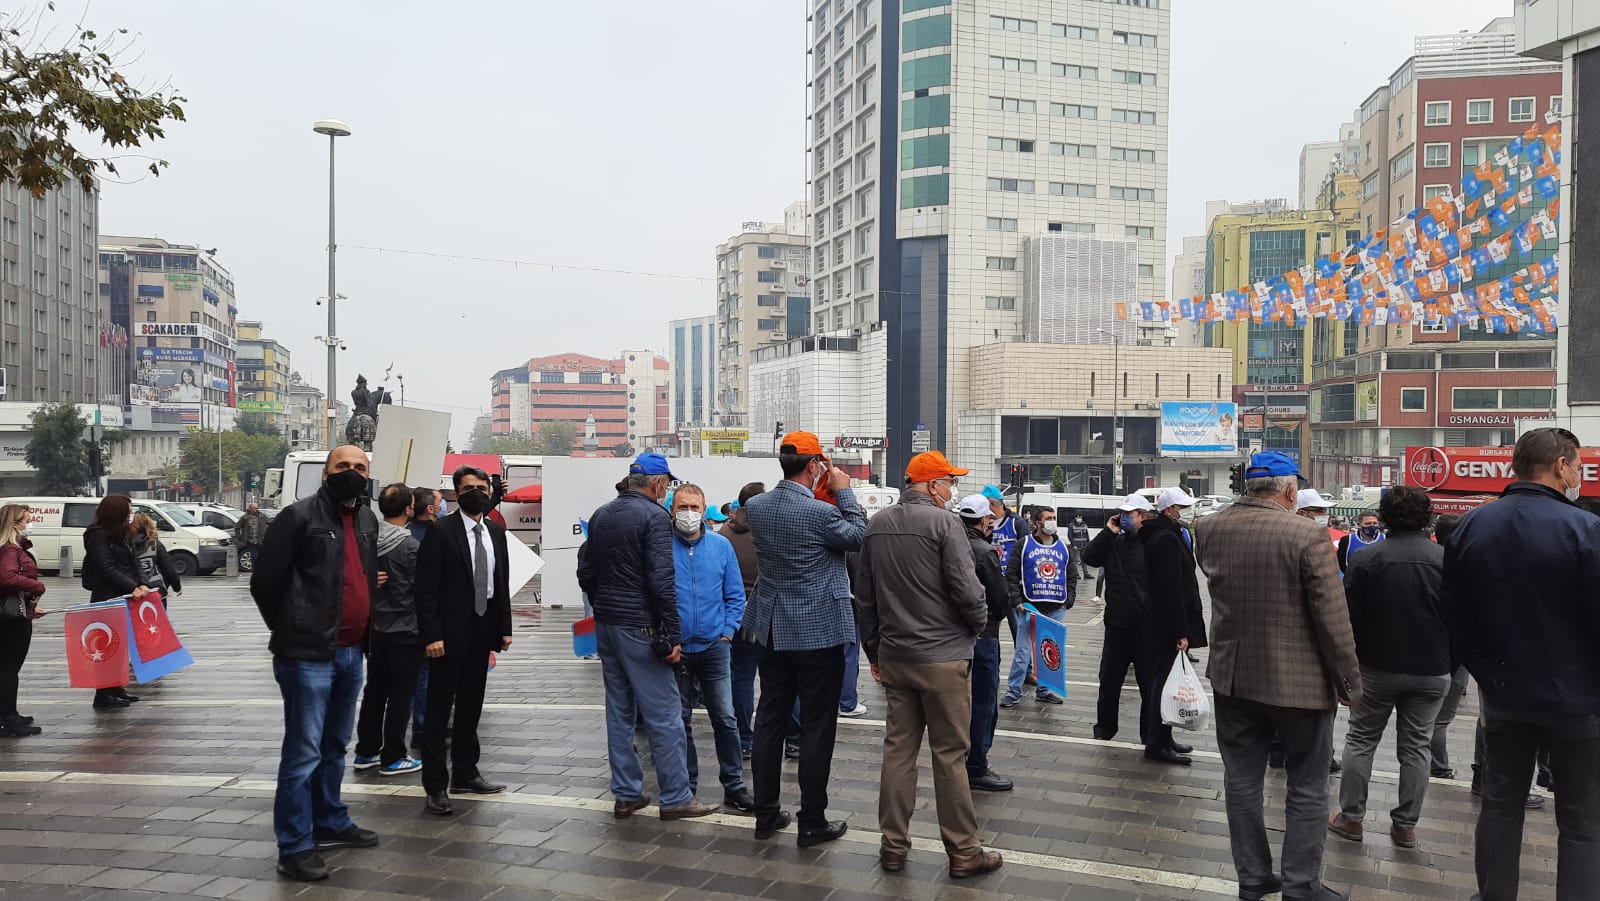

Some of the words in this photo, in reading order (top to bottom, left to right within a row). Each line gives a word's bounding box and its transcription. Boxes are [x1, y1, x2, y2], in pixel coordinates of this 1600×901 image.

[1449, 414, 1510, 424] OSMANGAZİ
[29, 507, 60, 515] OPLAMA
[519, 516, 536, 524] KAN
